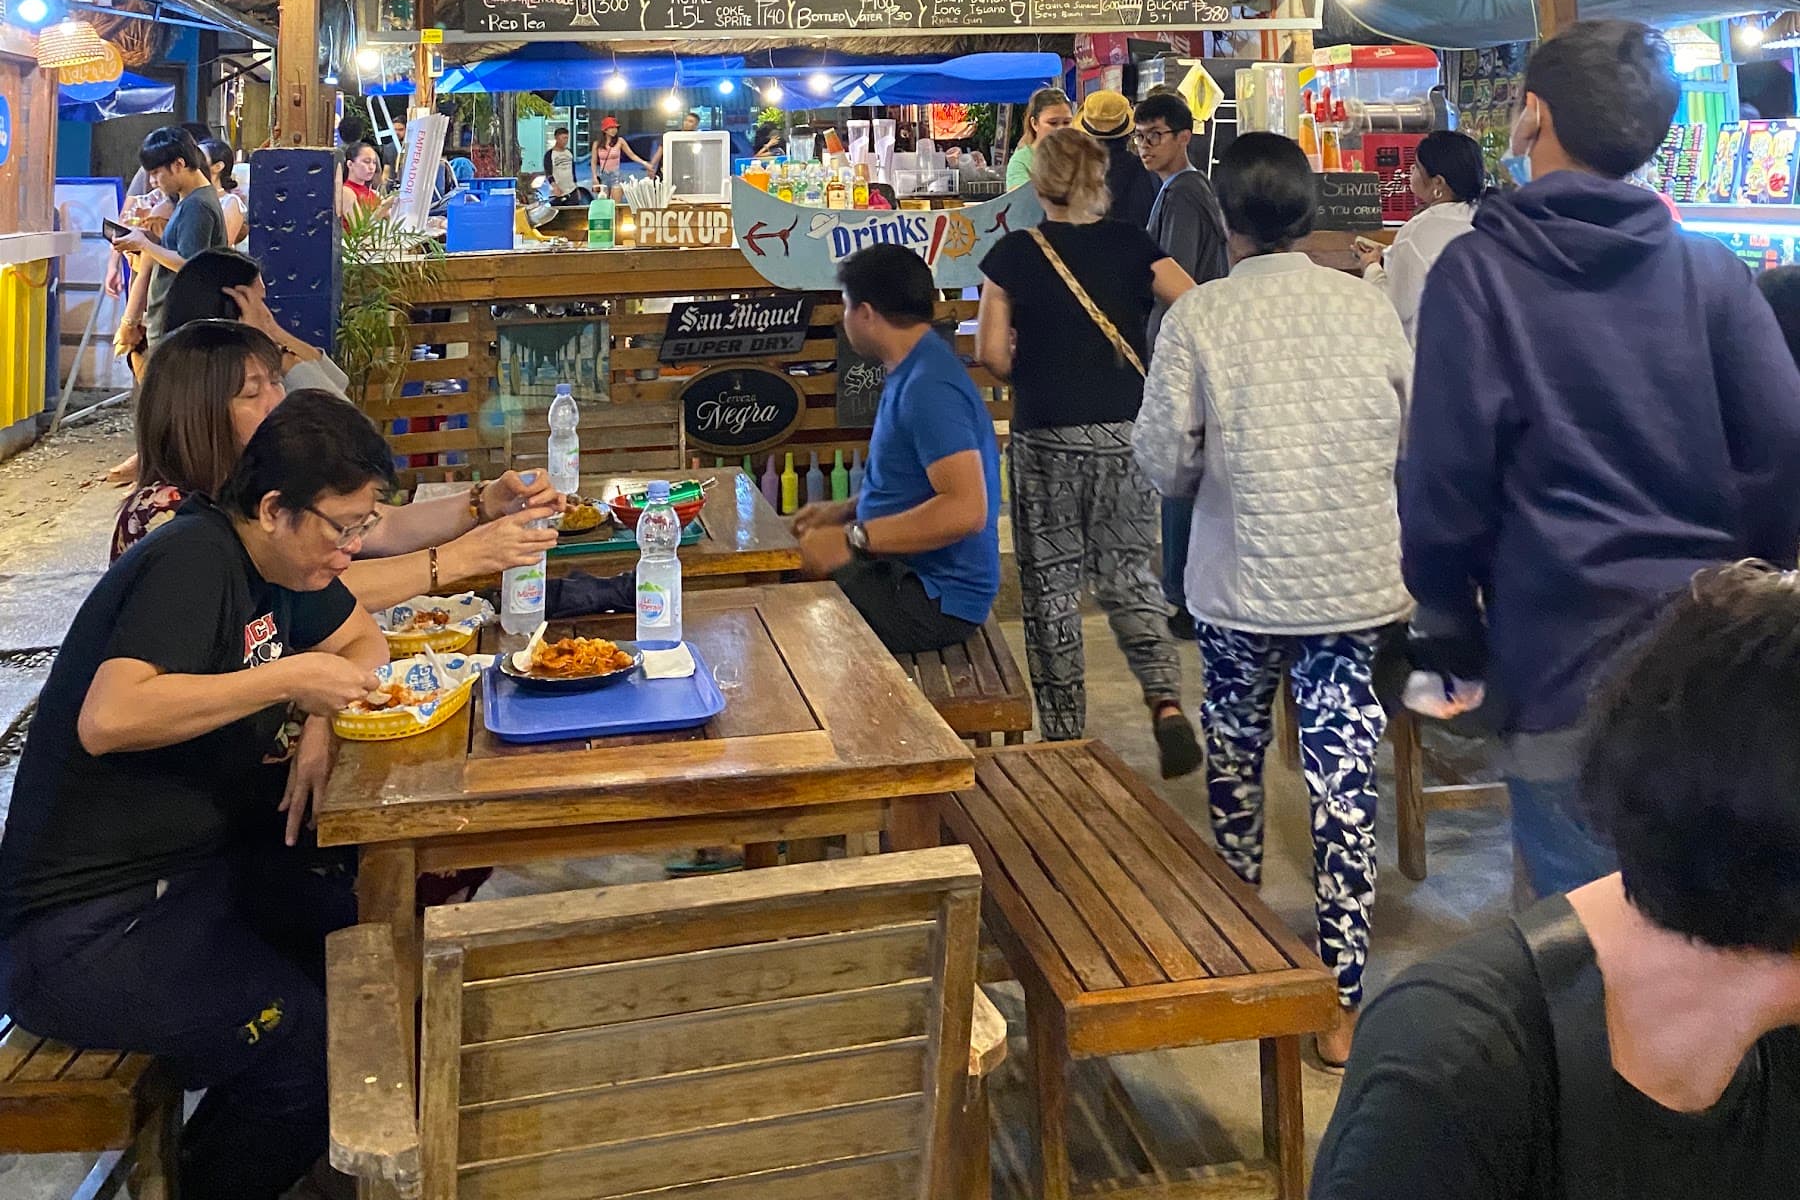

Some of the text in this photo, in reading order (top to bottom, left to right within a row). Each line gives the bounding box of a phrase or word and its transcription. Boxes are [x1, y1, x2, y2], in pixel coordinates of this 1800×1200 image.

[521, 12, 546, 31] Tea
[715, 15, 752, 27] SPRITE
[716, 5, 745, 16] COKE
[405, 129, 426, 195] EMPERADOR
[639, 210, 729, 244] PICK UP
[677, 298, 805, 333] San Miguel
[671, 338, 743, 357] SUPER
[696, 400, 780, 435] Negra
